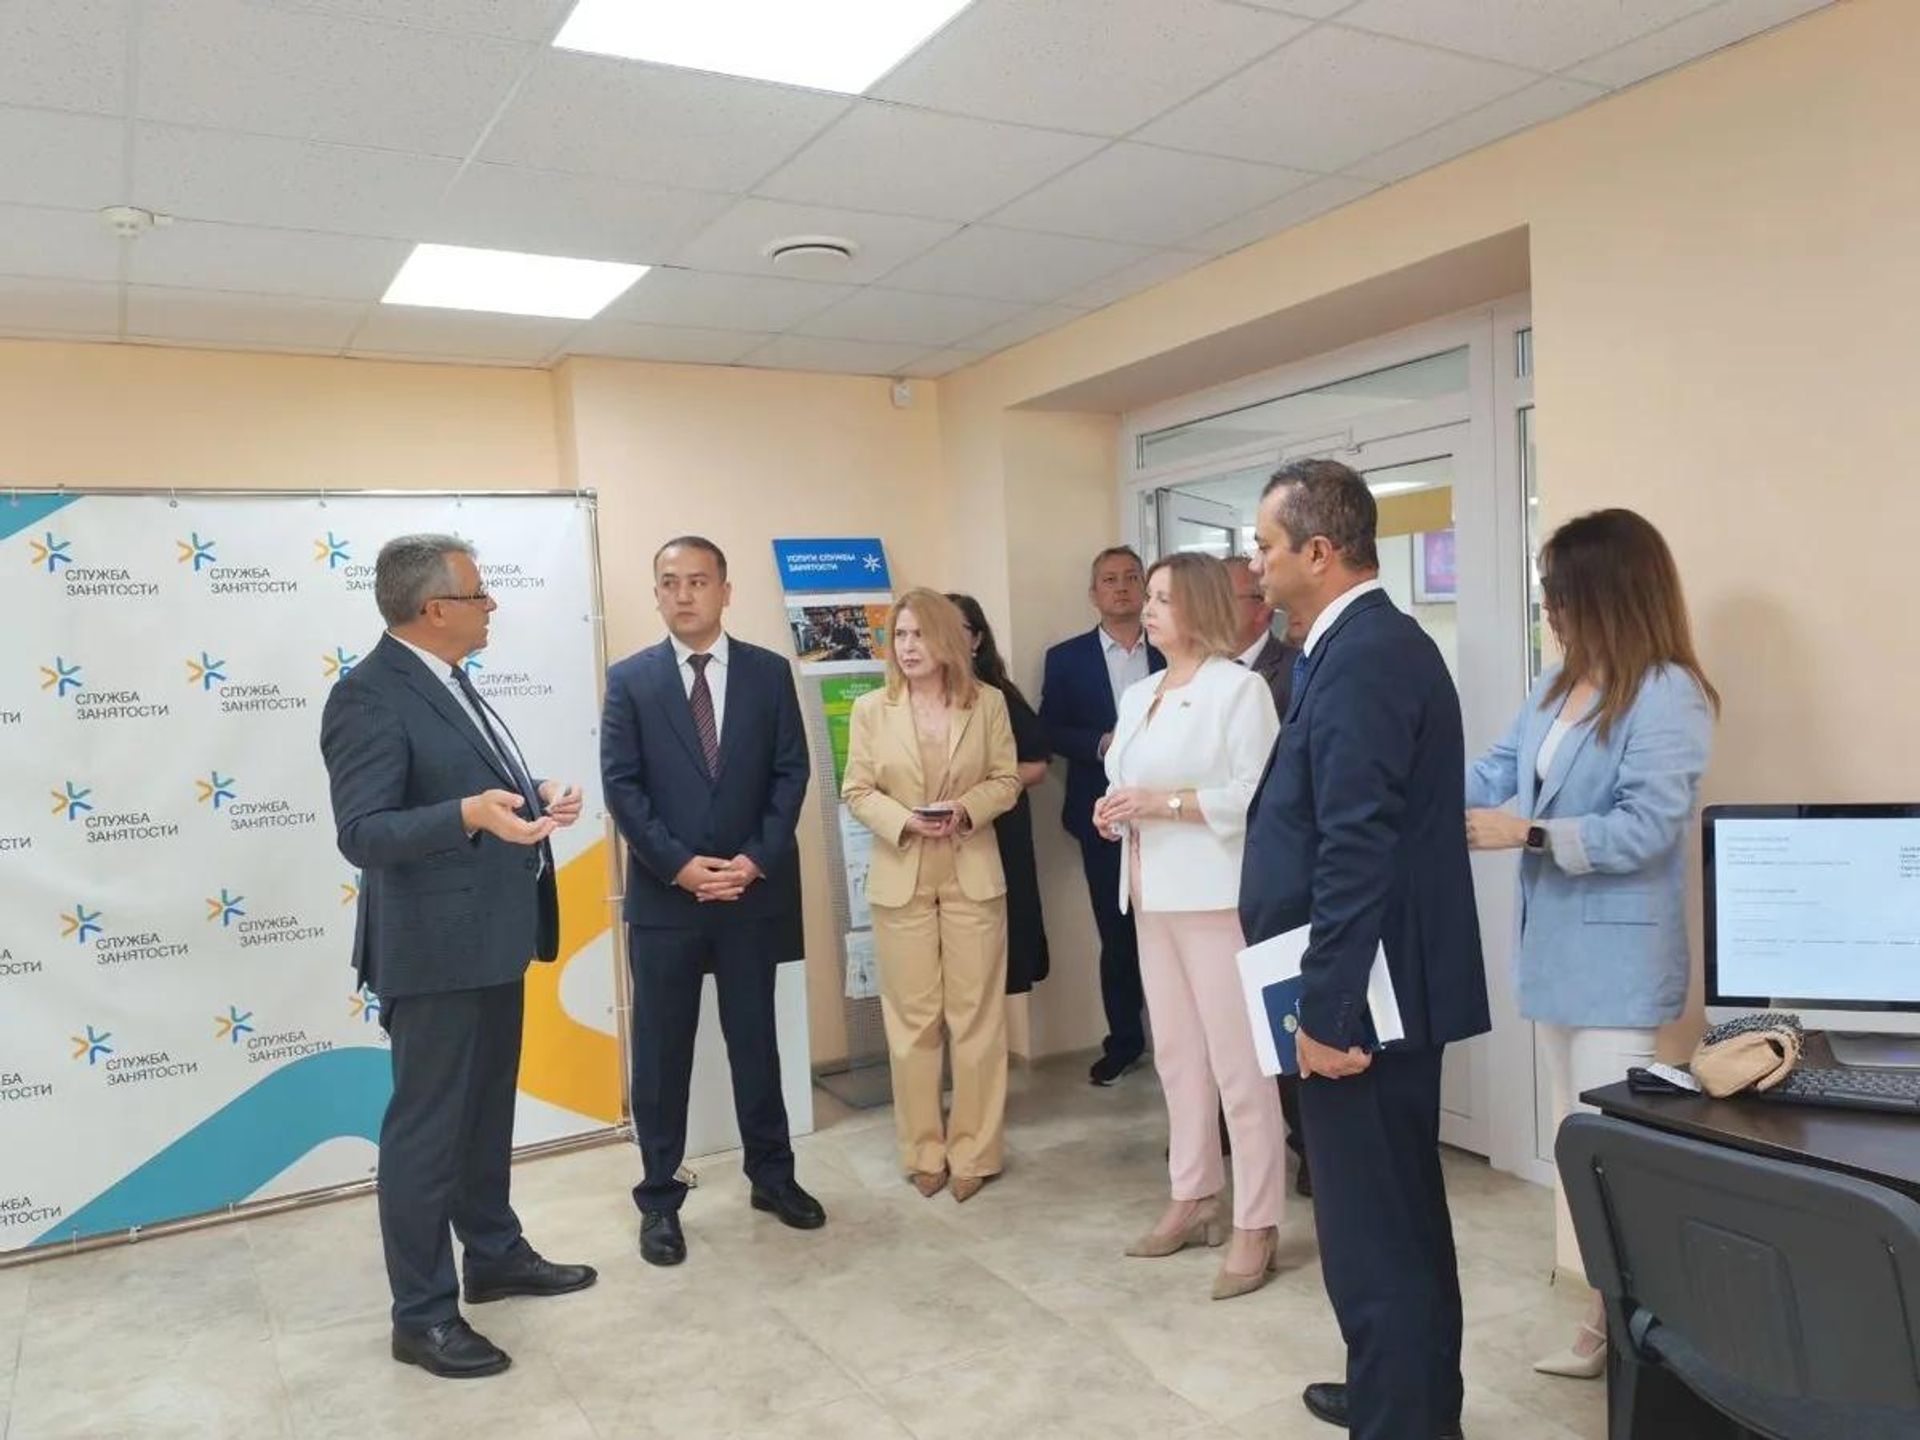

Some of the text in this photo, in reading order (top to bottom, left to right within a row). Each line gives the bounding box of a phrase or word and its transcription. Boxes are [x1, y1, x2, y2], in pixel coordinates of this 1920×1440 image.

[65, 569, 130, 581] СЛУЖБА
[210, 568, 270, 579] СЛУЖБА
[66, 584, 159, 596] ЗАНЯТОСТИ
[210, 581, 297, 593] ЗАНЯТОСТИ
[478, 673, 529, 685] СЛУЖБА
[75, 691, 140, 705] СЛУЖБА
[220, 684, 280, 698] СЛУЖБА
[77, 705, 169, 720] ЗАНЯТОСТИ
[221, 698, 307, 712] ЗАНЯТОСТИ
[229, 801, 289, 815] СЛУЖБА
[85, 813, 150, 828] СЛУЖБА
[230, 813, 316, 830] ЗАНЯТОСТИ
[87, 825, 179, 843] ЗАНЯТОСТИ
[238, 917, 299, 933] СЛУЖБА
[96, 933, 161, 950] СЛУЖБА
[239, 927, 325, 947] ЗАНЯТОСТИ
[97, 944, 189, 965] ЗАНЯТОСТИ
[247, 1030, 307, 1049] СЛУЖБА
[247, 1041, 333, 1063] ЗАНЯТОСТИ
[105, 1052, 170, 1071] СЛУЖБА
[107, 1062, 199, 1086] ЗАНЯТОСТИ
